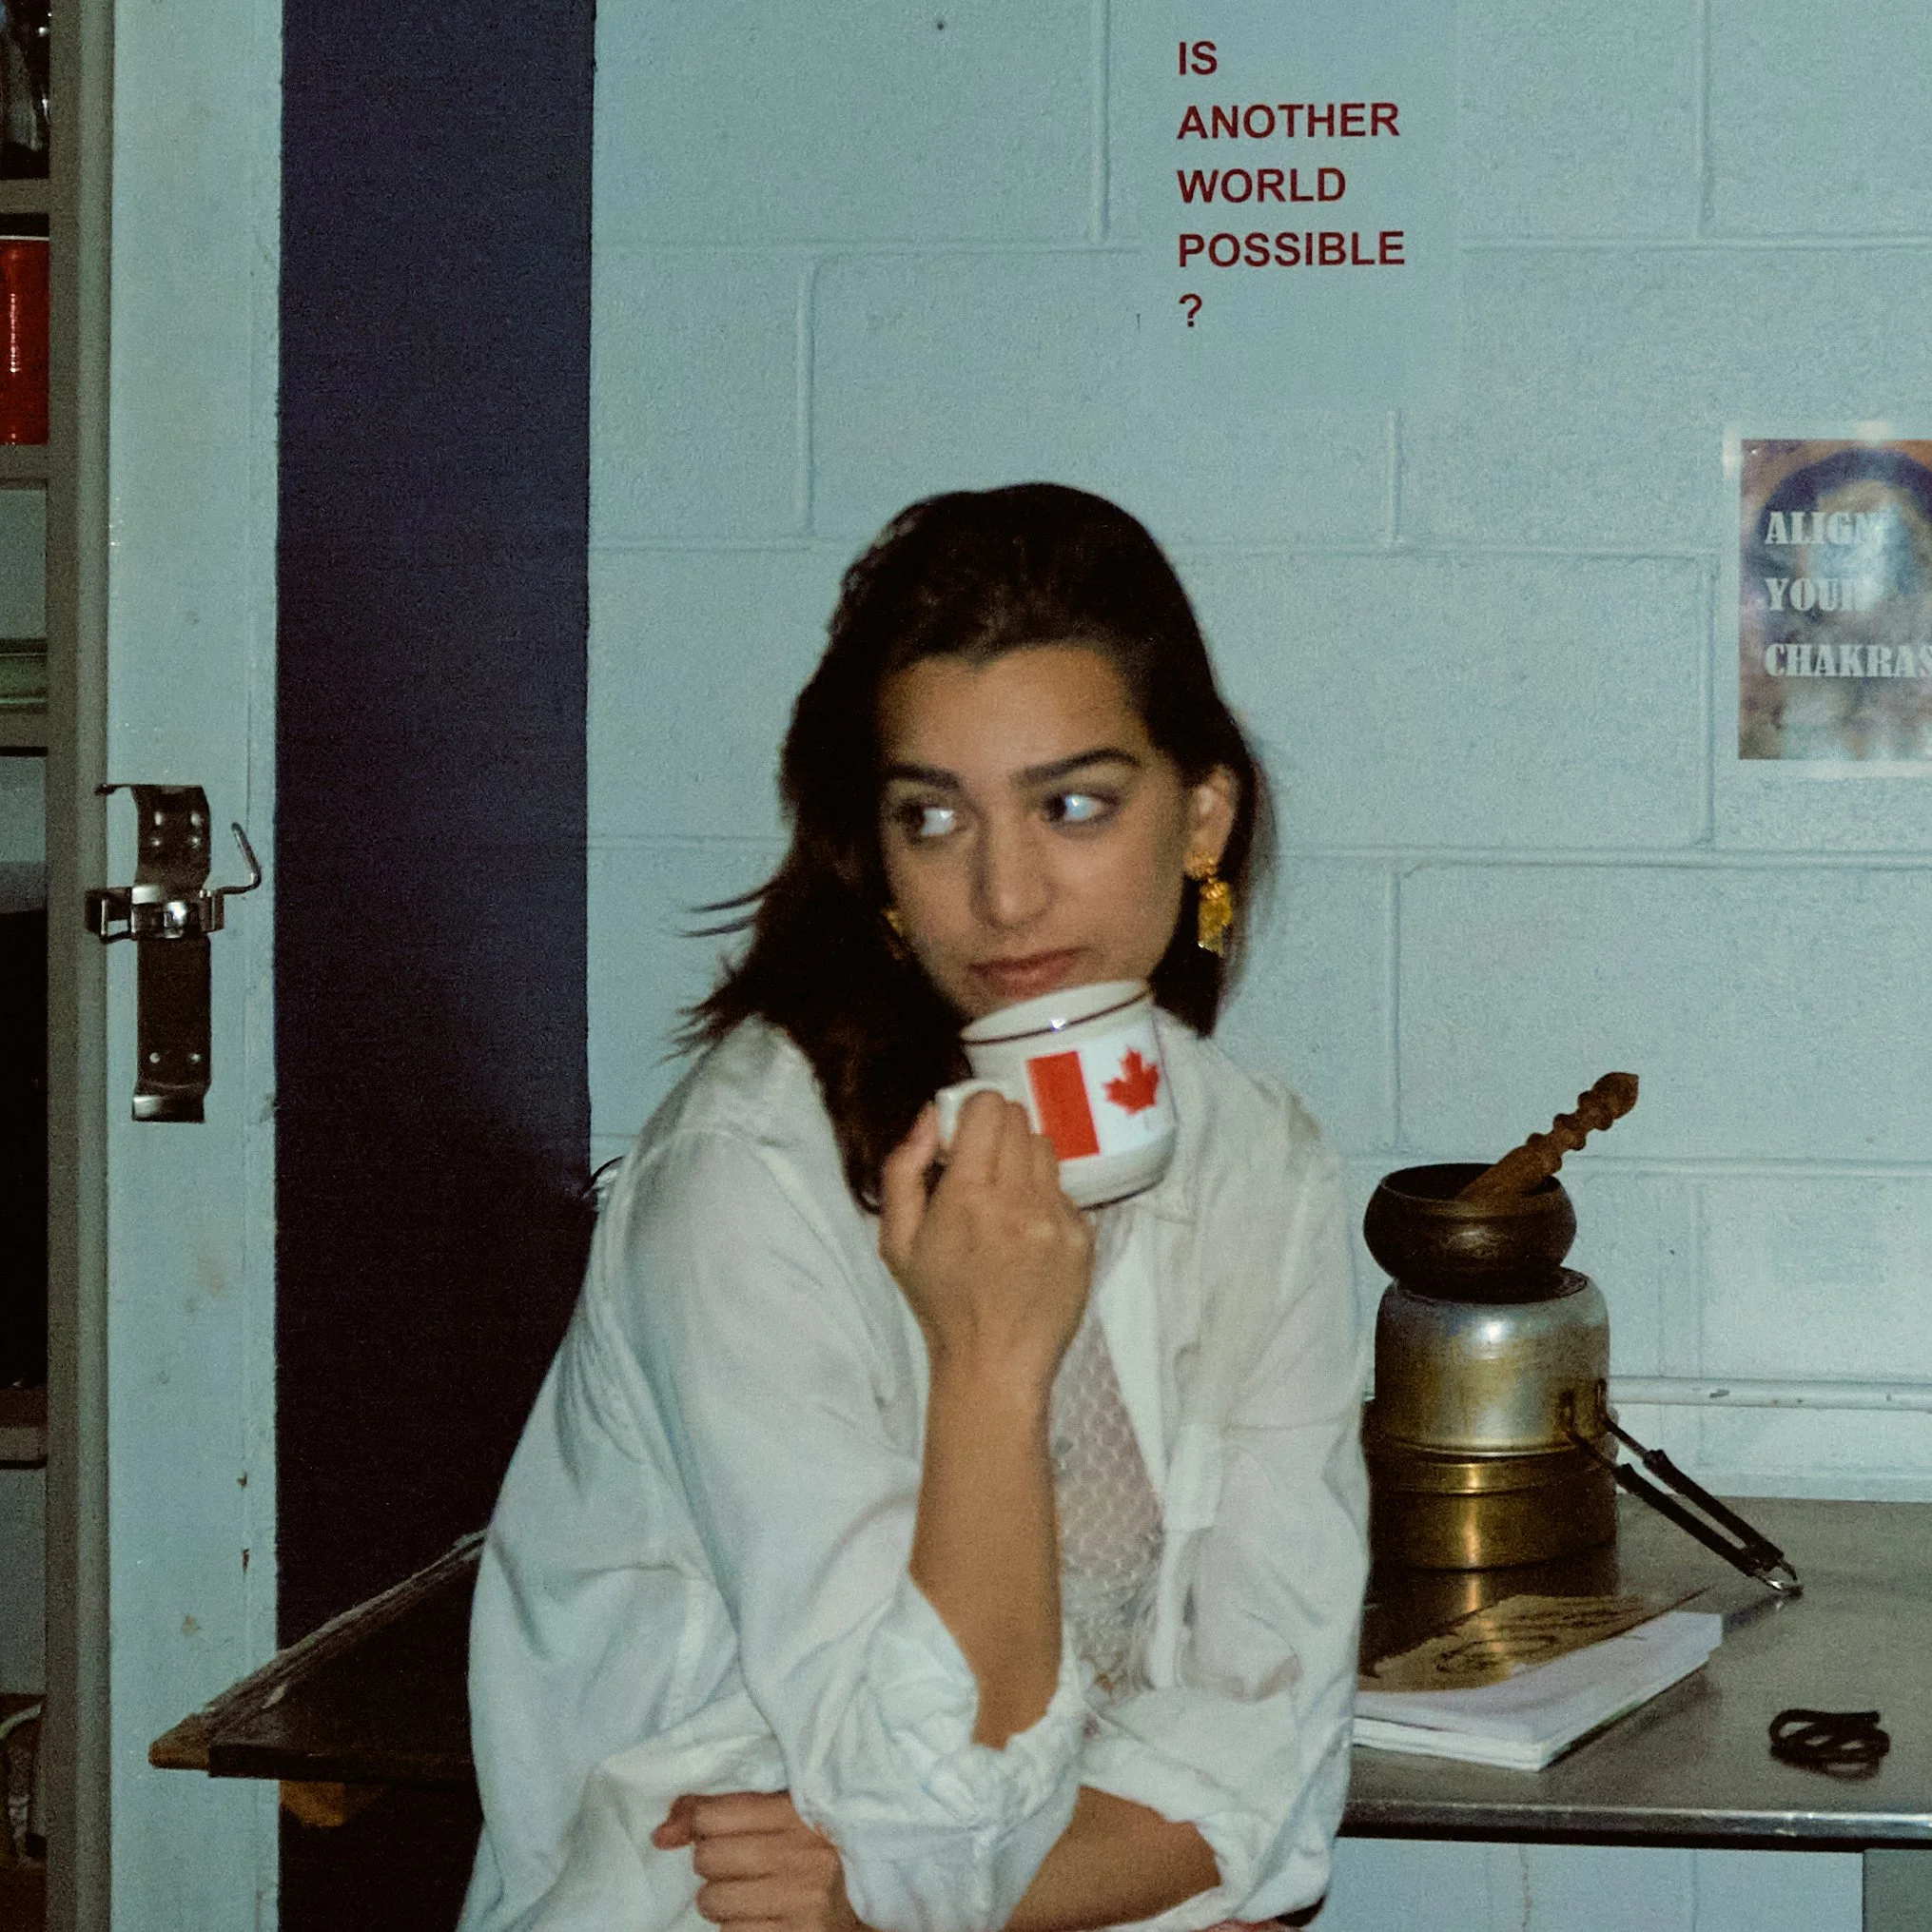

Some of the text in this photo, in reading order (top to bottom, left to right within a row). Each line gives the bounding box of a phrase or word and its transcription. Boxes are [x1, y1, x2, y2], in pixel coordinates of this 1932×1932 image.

[1179, 40, 1218, 76] IS
[1178, 102, 1400, 140] ANOTHER
[1178, 167, 1346, 204] WORLD
[1179, 230, 1405, 268] POSSIBLE
[1179, 293, 1202, 328] ?
[1764, 643, 1932, 677] CHAKRAS
